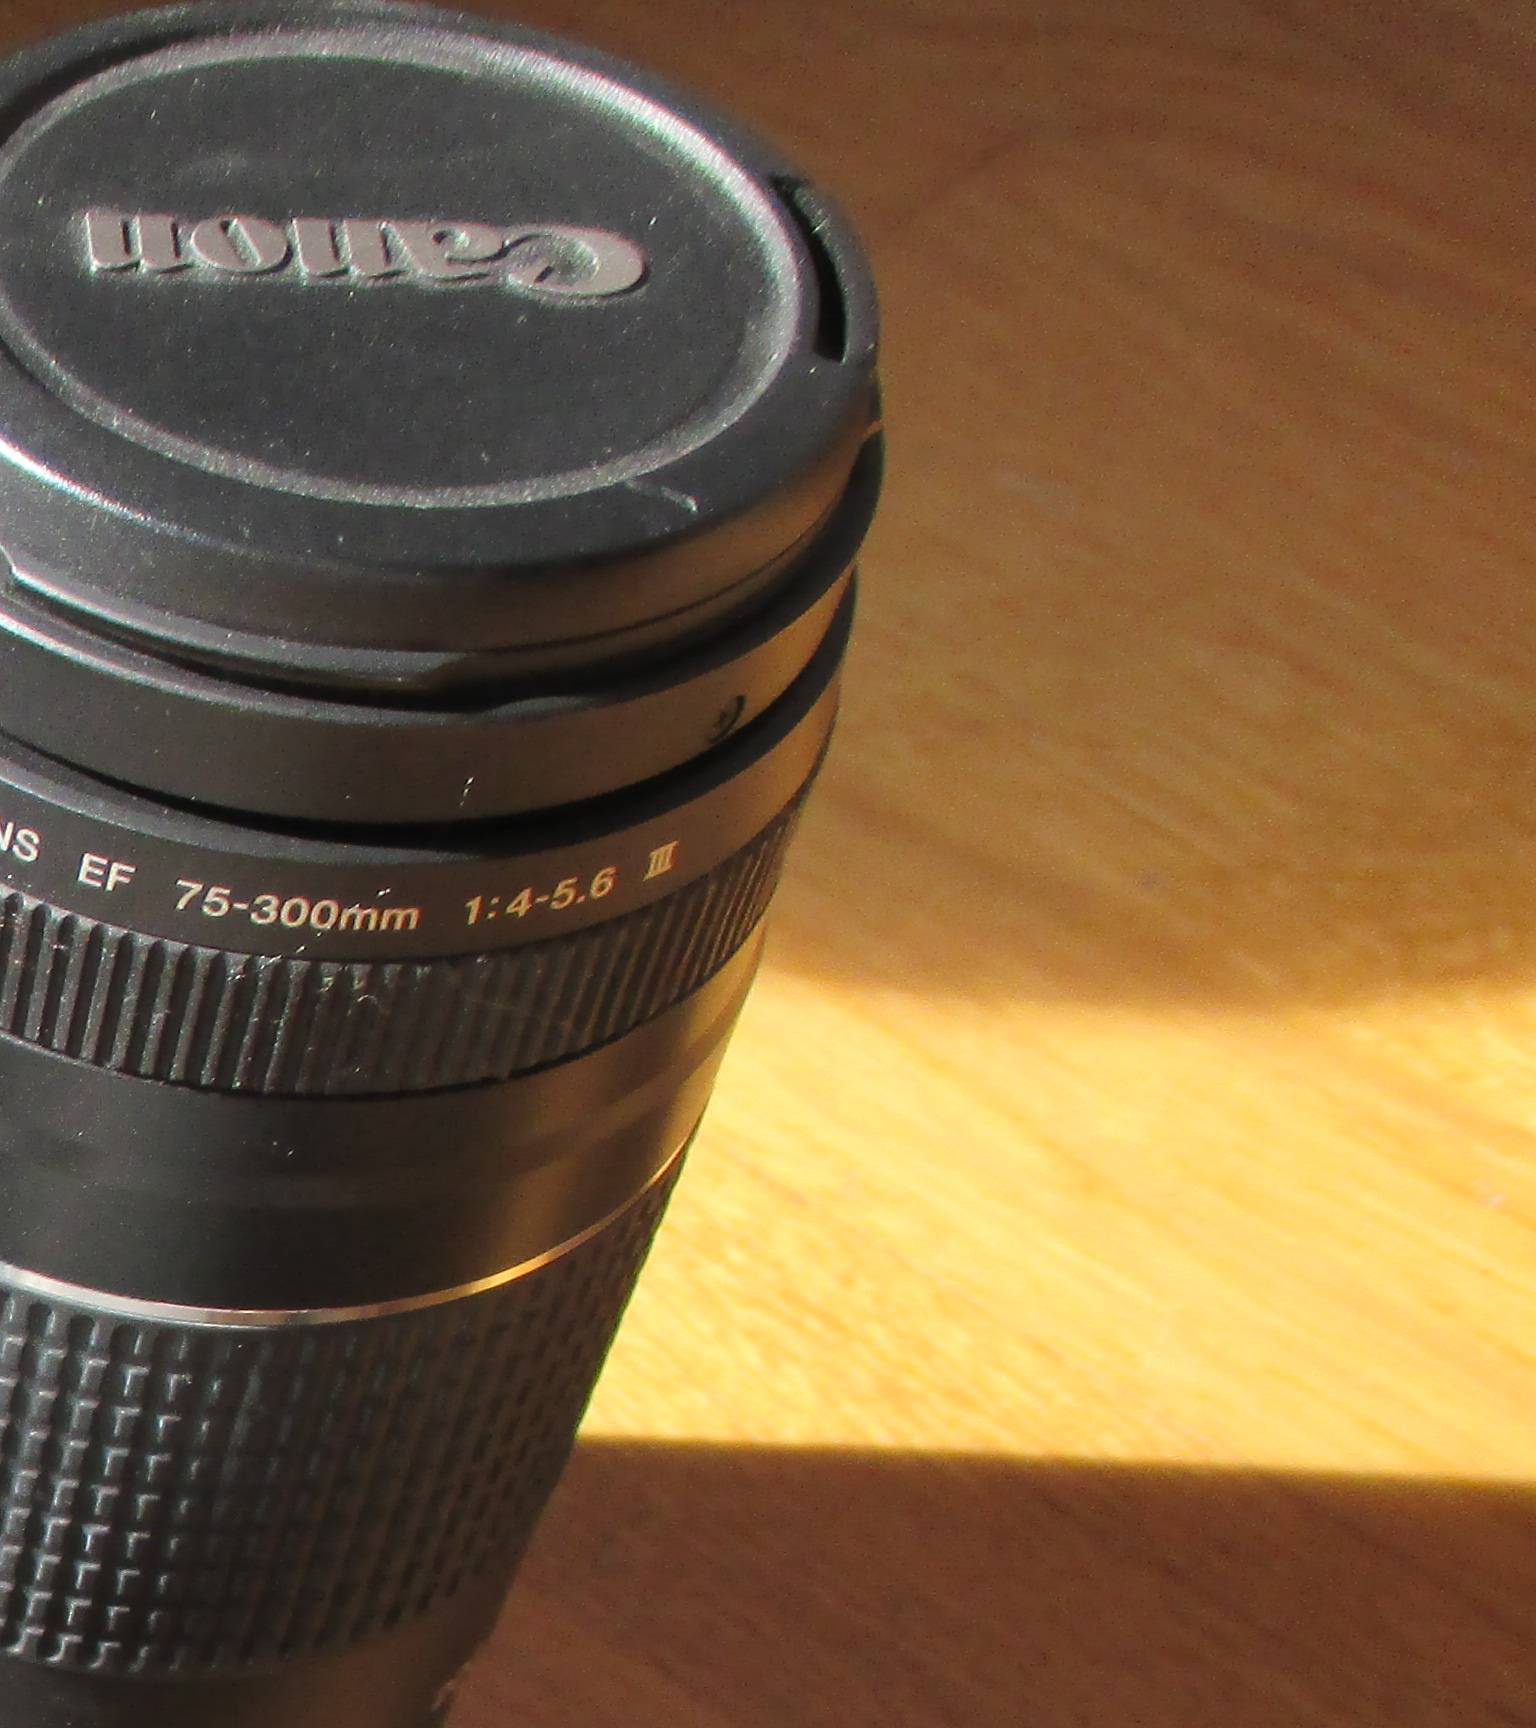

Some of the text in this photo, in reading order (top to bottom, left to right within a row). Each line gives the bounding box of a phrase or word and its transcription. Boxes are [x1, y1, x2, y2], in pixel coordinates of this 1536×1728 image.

[74, 209, 650, 301] Canon
[77, 852, 137, 894] EF
[173, 878, 423, 932] 75-300mm
[464, 865, 618, 926] 1:4-5.6
